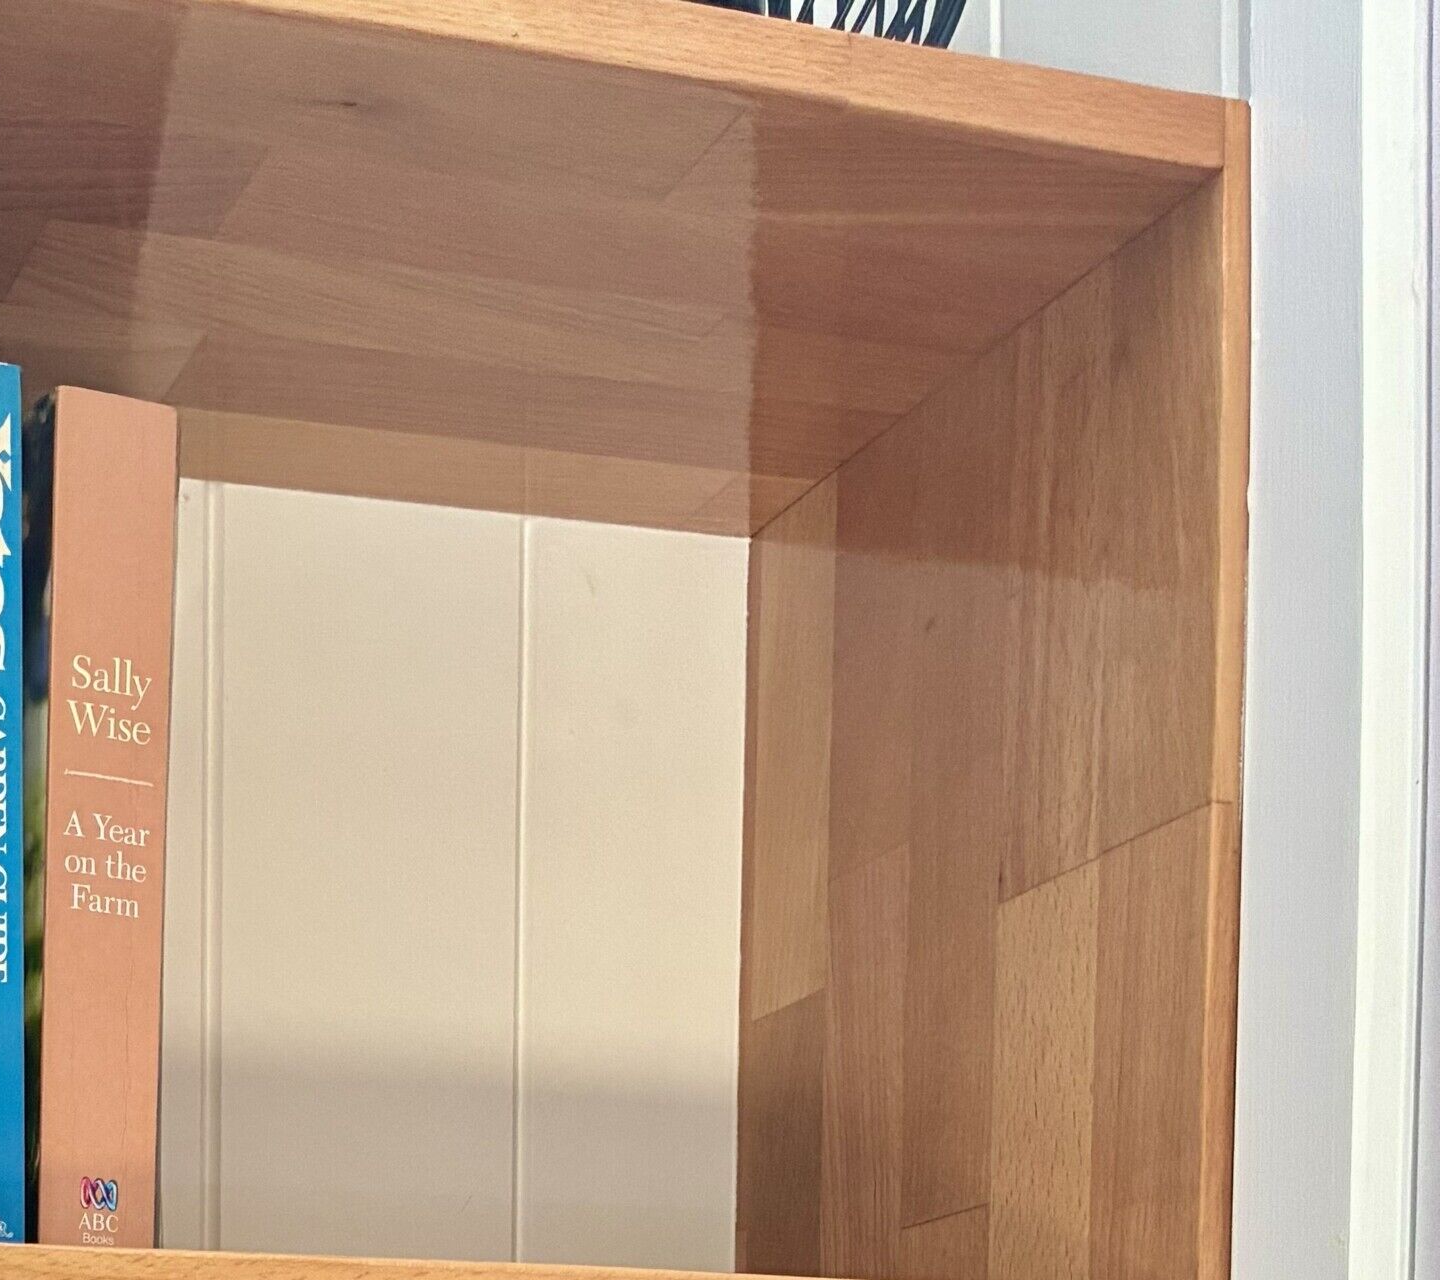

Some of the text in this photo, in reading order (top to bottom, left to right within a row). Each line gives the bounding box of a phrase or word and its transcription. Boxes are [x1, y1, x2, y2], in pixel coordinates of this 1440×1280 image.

[71, 654, 152, 711] Sally
[67, 699, 152, 745] Wise
[63, 810, 151, 848] A Year
[64, 852, 148, 883] on the
[70, 884, 140, 919] Farm
[78, 1213, 120, 1233] ABC
[82, 1233, 115, 1246] Books
